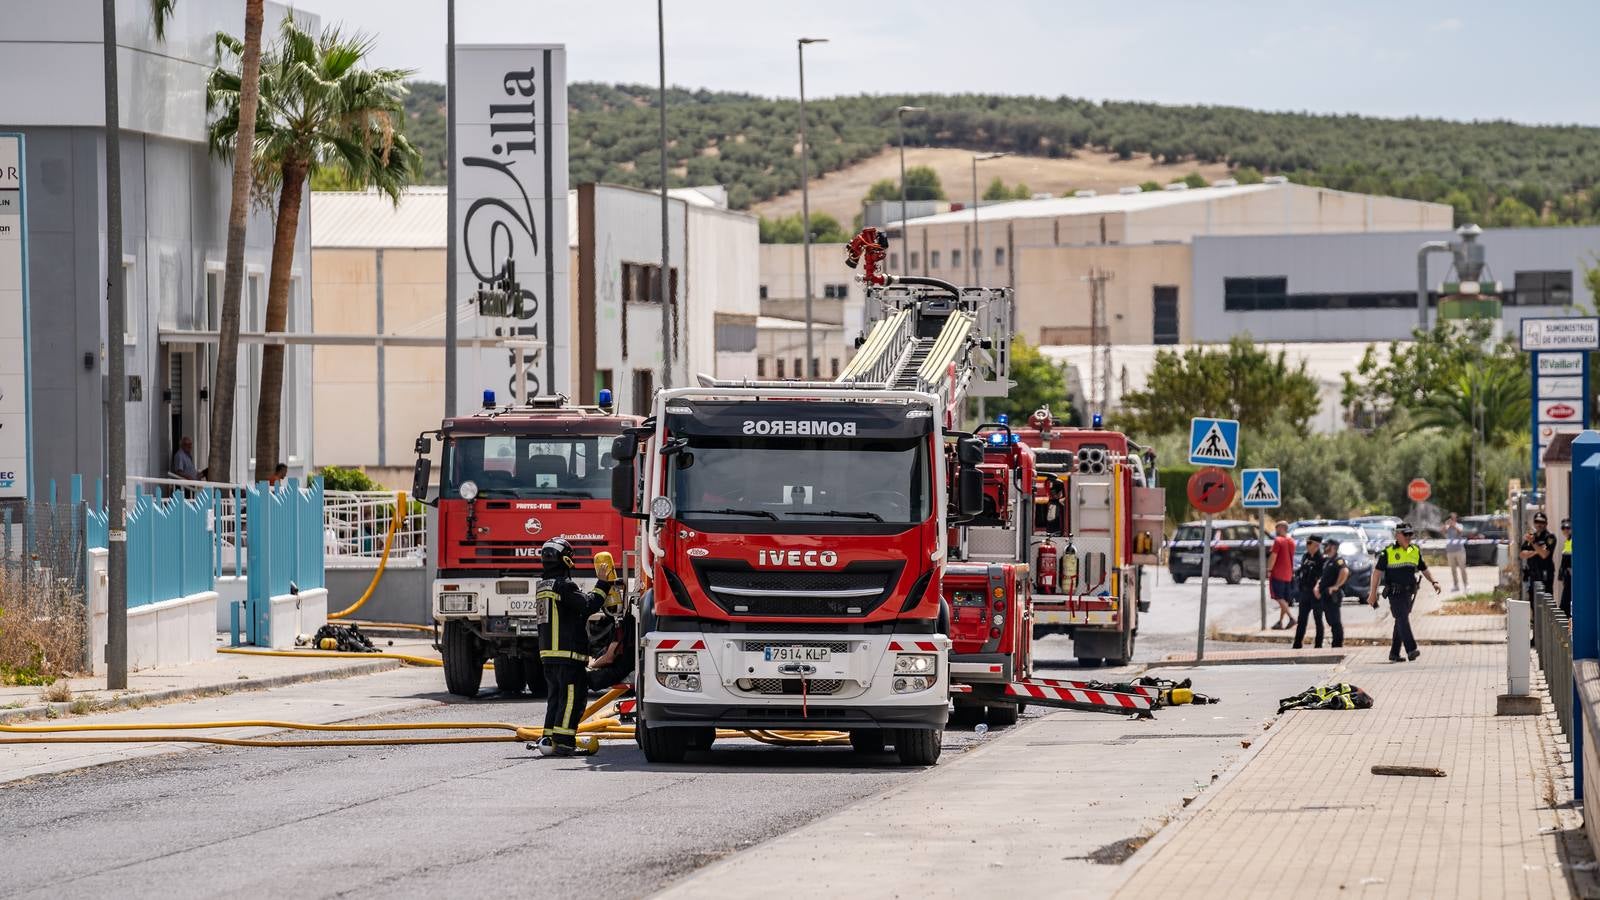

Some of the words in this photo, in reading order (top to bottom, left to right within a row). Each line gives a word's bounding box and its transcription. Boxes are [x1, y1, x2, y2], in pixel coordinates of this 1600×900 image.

[0, 166, 18, 180] R
[461, 66, 538, 285] Villa
[495, 288, 540, 400] orio
[1550, 358, 1580, 369] Vaillant
[515, 548, 542, 556] IVEC
[759, 549, 839, 567] IVECO
[773, 648, 802, 660] 7914
[805, 648, 828, 660] KLP
